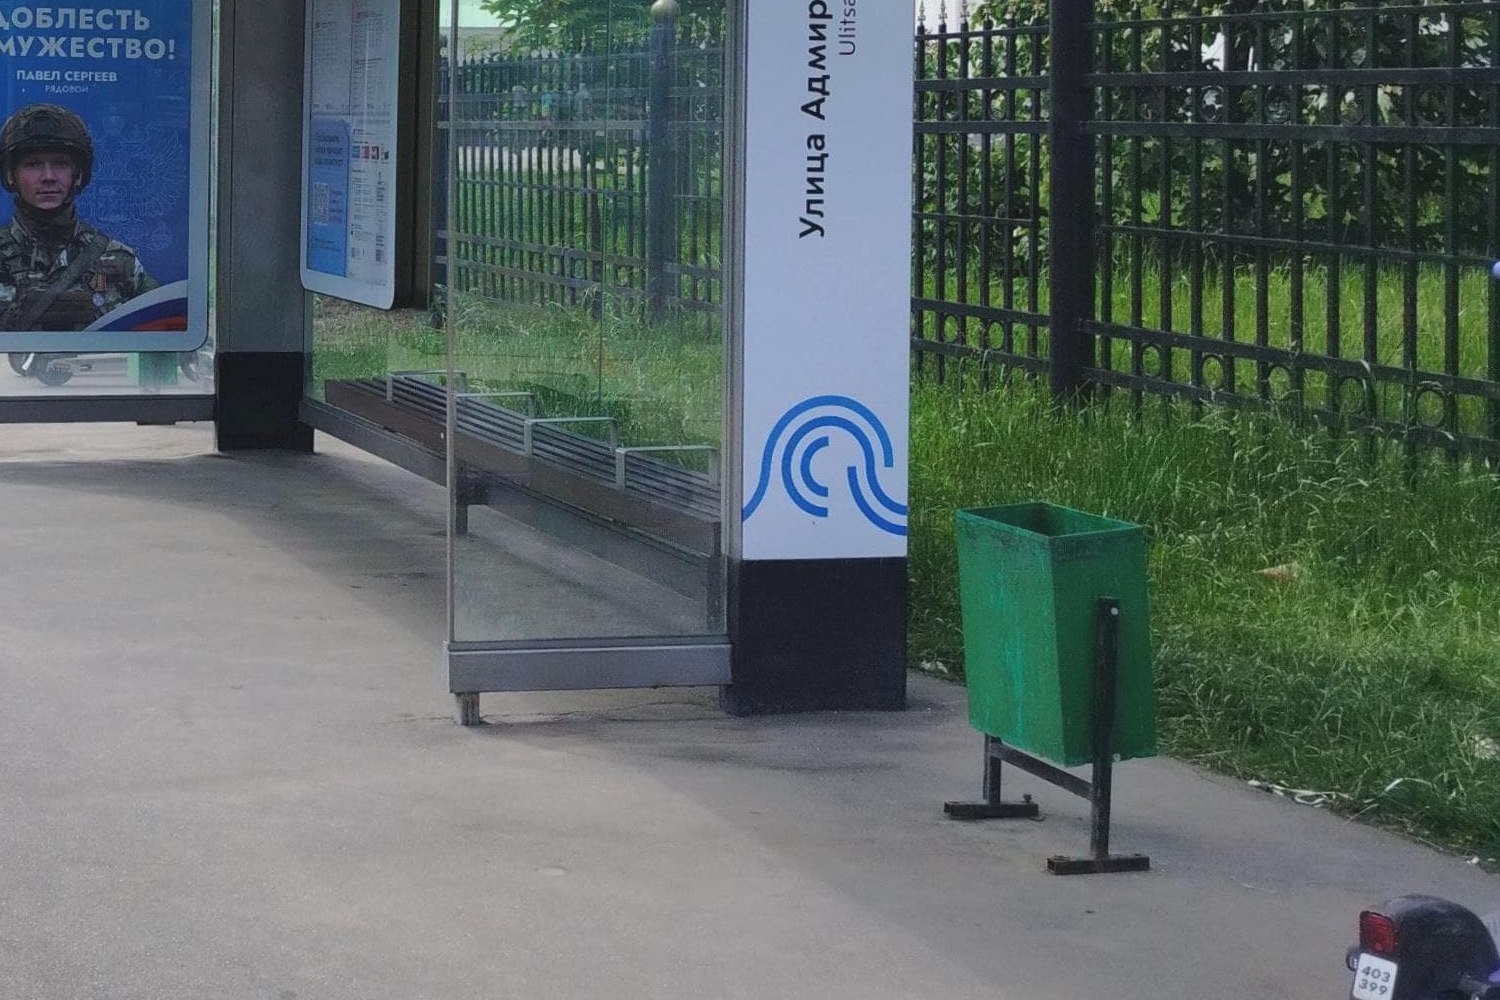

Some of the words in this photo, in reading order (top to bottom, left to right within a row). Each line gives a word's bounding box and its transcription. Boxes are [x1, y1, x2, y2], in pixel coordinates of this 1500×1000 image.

[16, 69, 61, 81] ПАВЕЛ
[64, 70, 118, 82] СЕРГЕЕВ
[44, 83, 90, 94] РЯДОВОЙ
[799, 134, 829, 239] Улица
[1362, 966, 1391, 983] 403
[1359, 979, 1388, 995] 399
